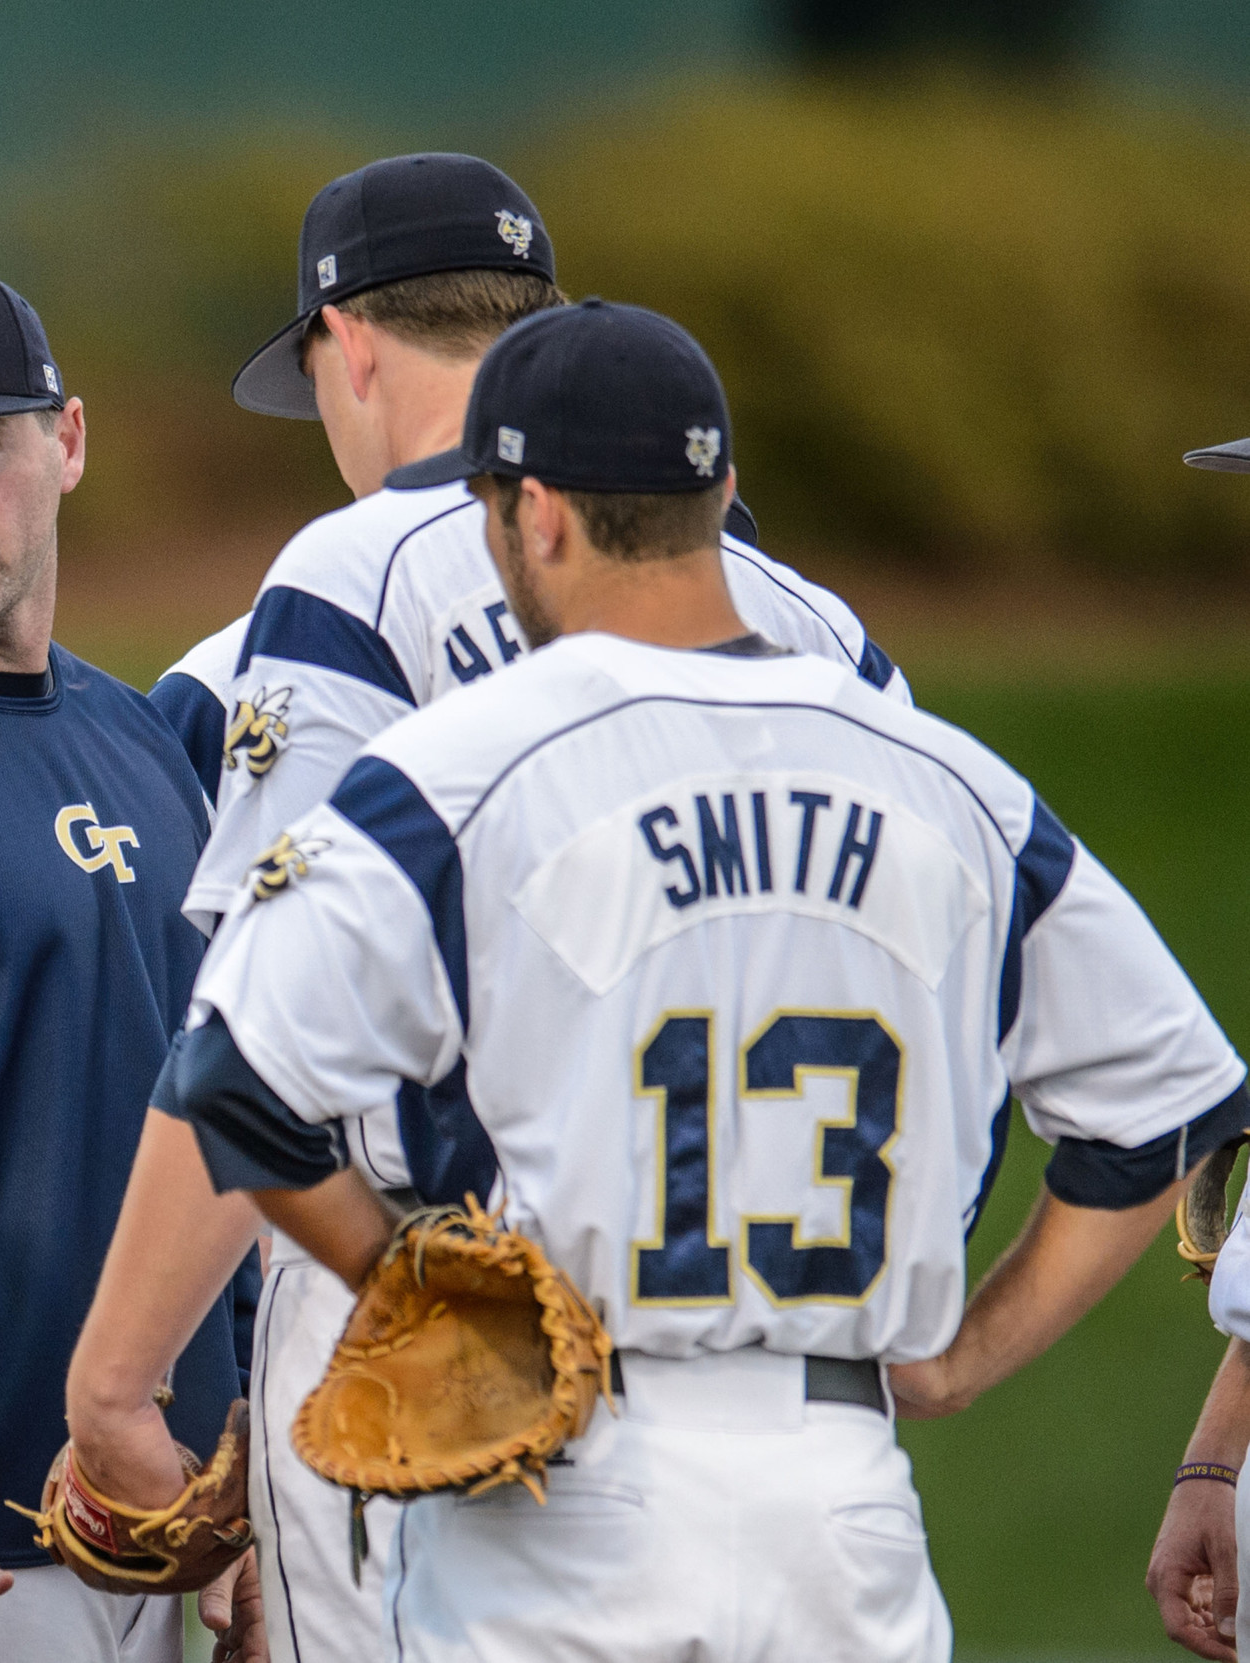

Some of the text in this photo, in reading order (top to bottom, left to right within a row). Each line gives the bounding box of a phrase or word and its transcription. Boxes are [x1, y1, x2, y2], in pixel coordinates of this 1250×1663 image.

[54, 801, 141, 883] GT
[637, 791, 885, 911] SMITH
[631, 1008, 906, 1307] 13
